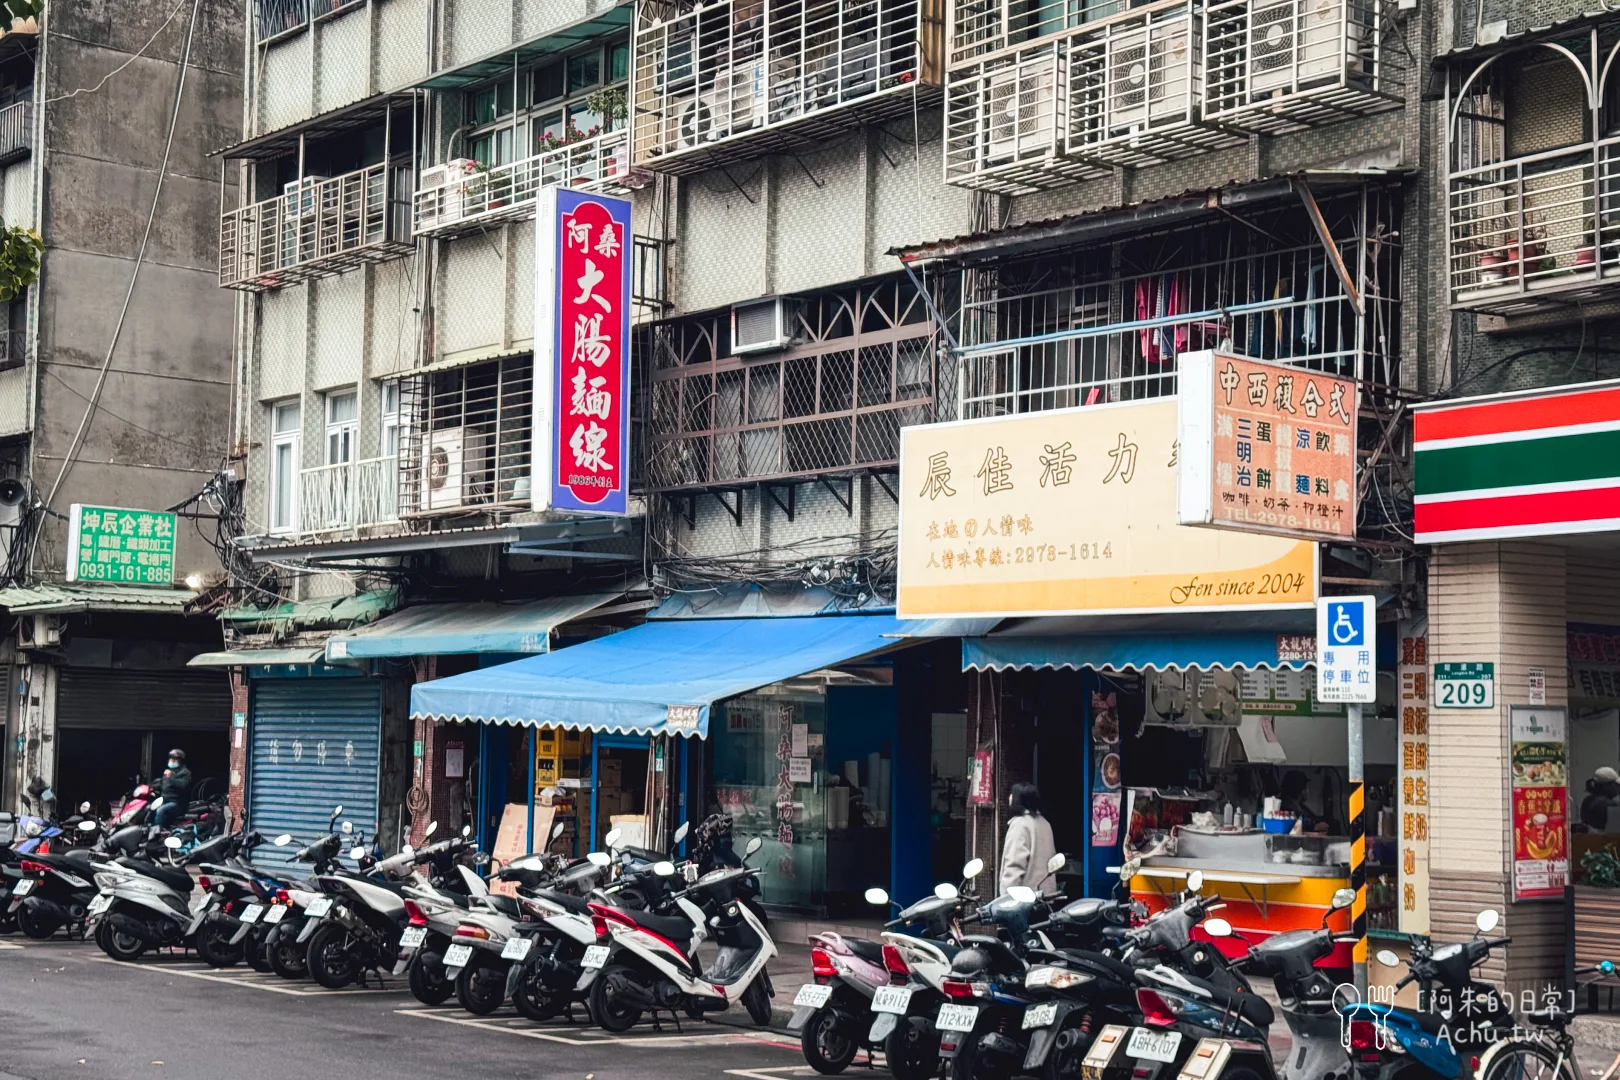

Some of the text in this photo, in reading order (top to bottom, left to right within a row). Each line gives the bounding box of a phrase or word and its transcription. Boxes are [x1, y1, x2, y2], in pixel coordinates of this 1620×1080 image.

[566, 218, 620, 258] 阿桑
[919, 431, 1178, 501] 辰佳活力
[1237, 418, 1252, 488] 三明治
[1256, 420, 1272, 489] 蛋餅
[1295, 427, 1311, 497] 涼麵
[1315, 430, 1330, 497] 飲料
[82, 510, 172, 538] 坤辰企業社
[926, 513, 1034, 542] 在地の人情味
[80, 562, 171, 582] 0931-161-885
[1216, 578, 1255, 596] since
[1257, 572, 1306, 595] 2004
[1279, 636, 1317, 651] 大龍帆
[1323, 650, 1370, 666] 專用
[1323, 668, 1370, 684] 停車位
[1442, 683, 1486, 704] 209
[1130, 1035, 1177, 1056] ABH-6107
